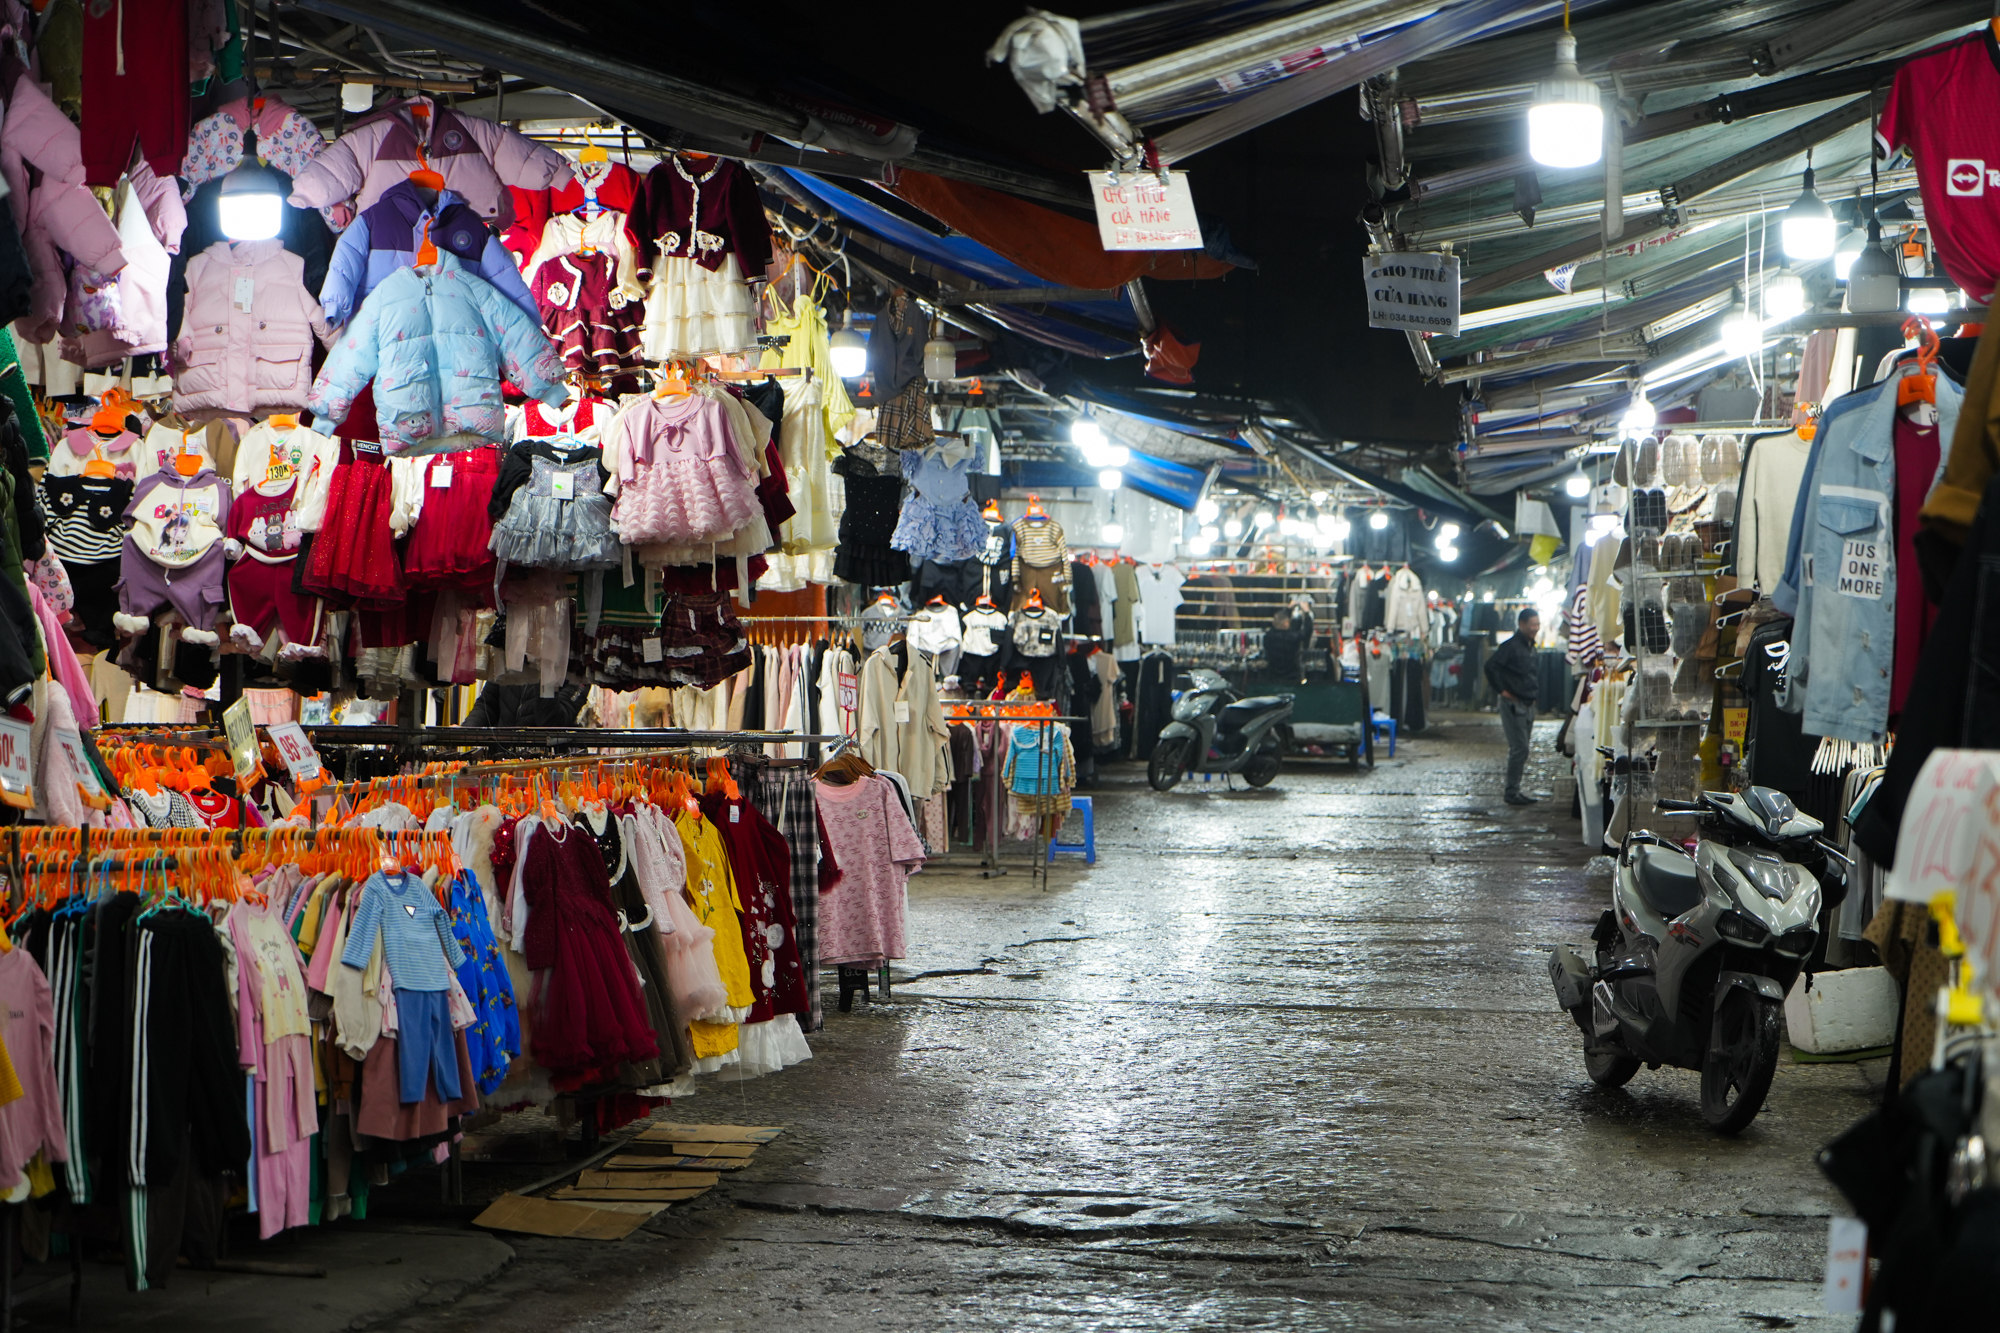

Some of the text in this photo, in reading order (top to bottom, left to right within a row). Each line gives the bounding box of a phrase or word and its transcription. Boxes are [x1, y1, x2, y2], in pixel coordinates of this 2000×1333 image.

[1103, 186, 1128, 204] CHO
[1371, 265, 1447, 282] CHO THUÊ
[1374, 285, 1448, 308] CỬA HÀNG
[1373, 310, 1452, 326] LH: 034.842.6599
[1847, 542, 1876, 558] JUS
[1849, 561, 1879, 577] ONE
[1840, 577, 1883, 595] MORE
[0, 733, 14, 769] 0K
[278, 733, 301, 763] 95K
